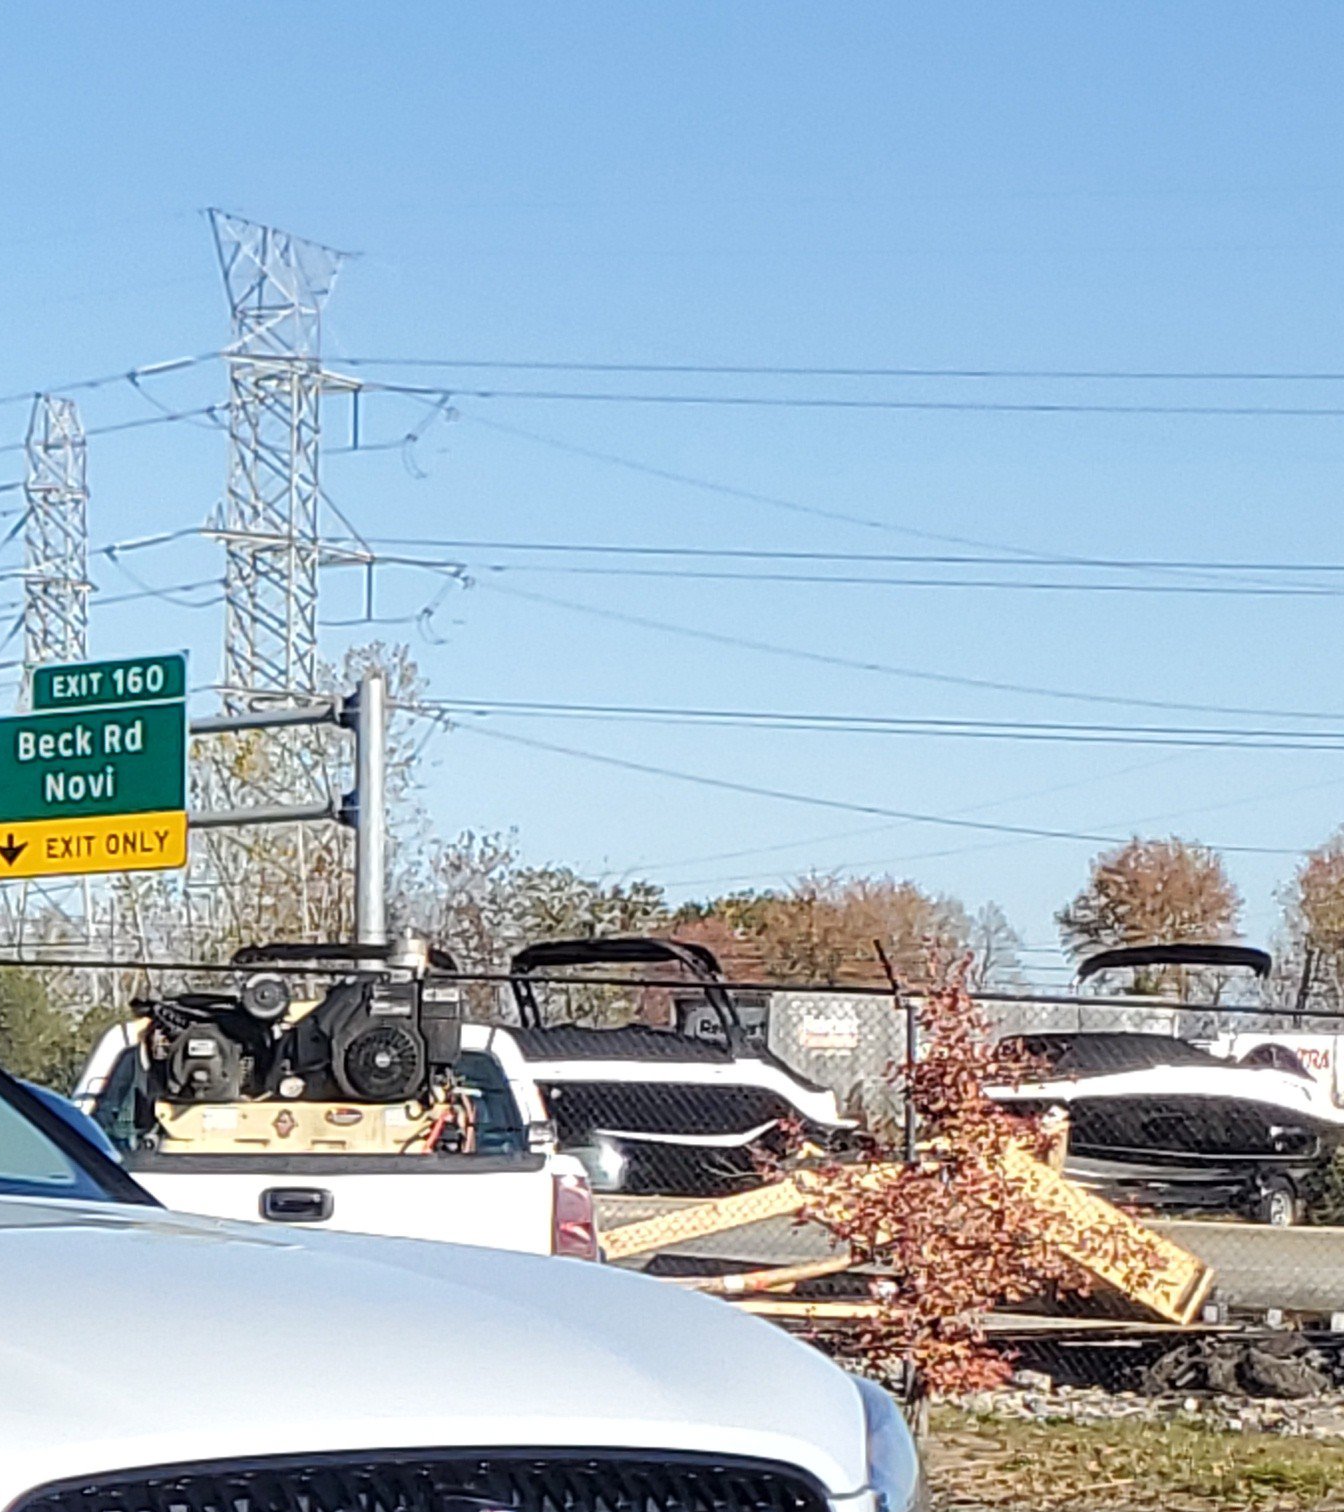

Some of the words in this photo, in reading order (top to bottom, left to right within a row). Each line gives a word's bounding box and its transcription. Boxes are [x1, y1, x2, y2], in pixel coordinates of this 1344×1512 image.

[52, 673, 102, 698] EXIT
[113, 665, 164, 695] 160
[18, 725, 92, 761] Beck
[104, 720, 143, 753] Rd
[45, 766, 115, 802] Novi
[47, 836, 96, 859] EXIT
[105, 831, 169, 855] ONLY
